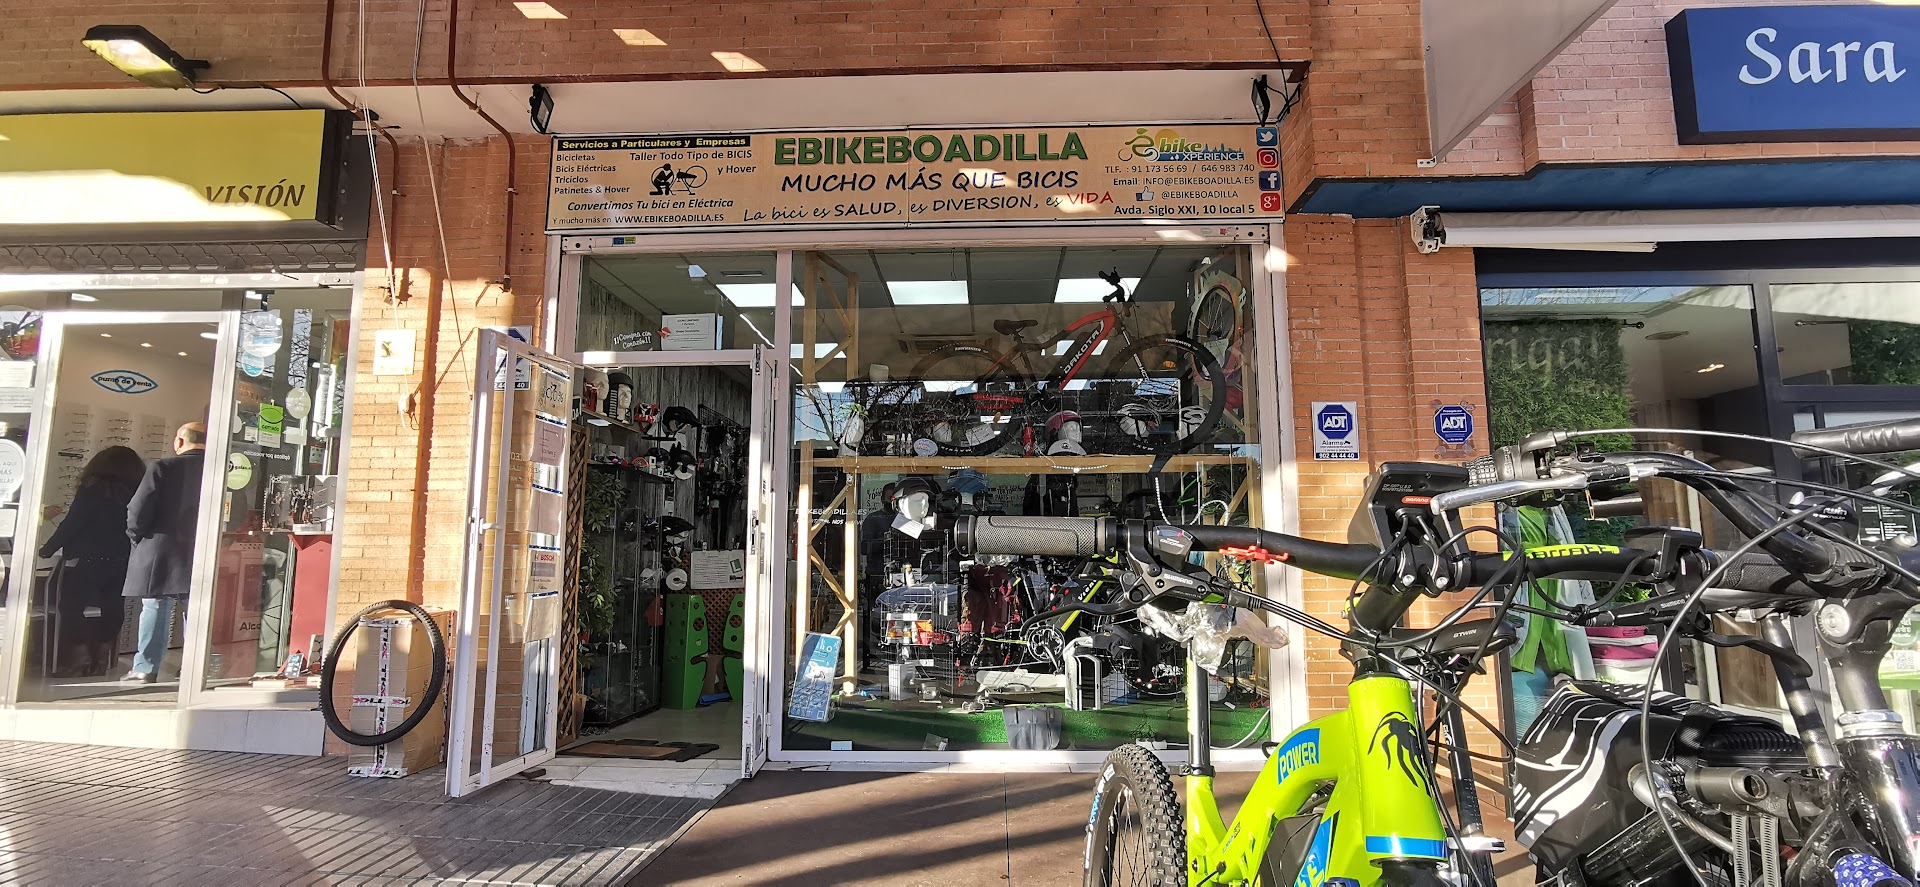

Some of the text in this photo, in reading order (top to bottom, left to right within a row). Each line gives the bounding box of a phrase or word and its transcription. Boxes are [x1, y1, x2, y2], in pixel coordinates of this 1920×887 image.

[1738, 27, 1907, 85] Sara
[562, 139, 608, 149] Servicios
[621, 138, 683, 149] Particulares
[684, 139, 692, 148] y
[696, 137, 746, 148] Empresas
[774, 131, 1088, 166] EBIKEBOADILLA
[556, 153, 597, 162] Bicicletas
[630, 150, 752, 163] Taller Todo Tipo de BICIS
[1183, 152, 1245, 161] XPERIENCE
[556, 163, 617, 173] Bicis Eléctricas
[717, 164, 756, 176] y Hover
[1105, 165, 1121, 173] TLF.
[1132, 165, 1142, 173] 91
[1145, 165, 1161, 173] 173
[1163, 165, 1174, 173] 56
[1176, 165, 1187, 173] 69
[1201, 164, 1217, 173] 646
[1220, 164, 1236, 173] 983
[1239, 164, 1255, 172] 740
[555, 175, 589, 184] Triciclos
[781, 167, 1079, 193] MUCHO MÁS QUE BICIS
[1113, 176, 1255, 187] Email: INFO@EBIKEBOADILLA.ES
[205, 178, 306, 208] VISIÓN
[554, 185, 594, 195] Patinetes
[604, 184, 630, 194] Hover
[1161, 190, 1239, 200] @EBIKEBOADILLA
[567, 197, 734, 212] Convertimos Tu bici en Eléctrica
[743, 191, 1114, 222] La bici es SALUD, es DIVERSION, es VIDA
[1114, 204, 1255, 217] Avda. Siglo XXI, 10 local 5
[559, 217, 583, 225] mucho
[614, 213, 724, 225] WWW.EBIKEBOADILLA.ES
[1063, 329, 1100, 375] DAKOTA
[1324, 415, 1347, 428] ADT
[1442, 416, 1466, 429] ADT
[1163, 573, 1194, 585] SHIMANO
[1279, 742, 1318, 773] POWER
